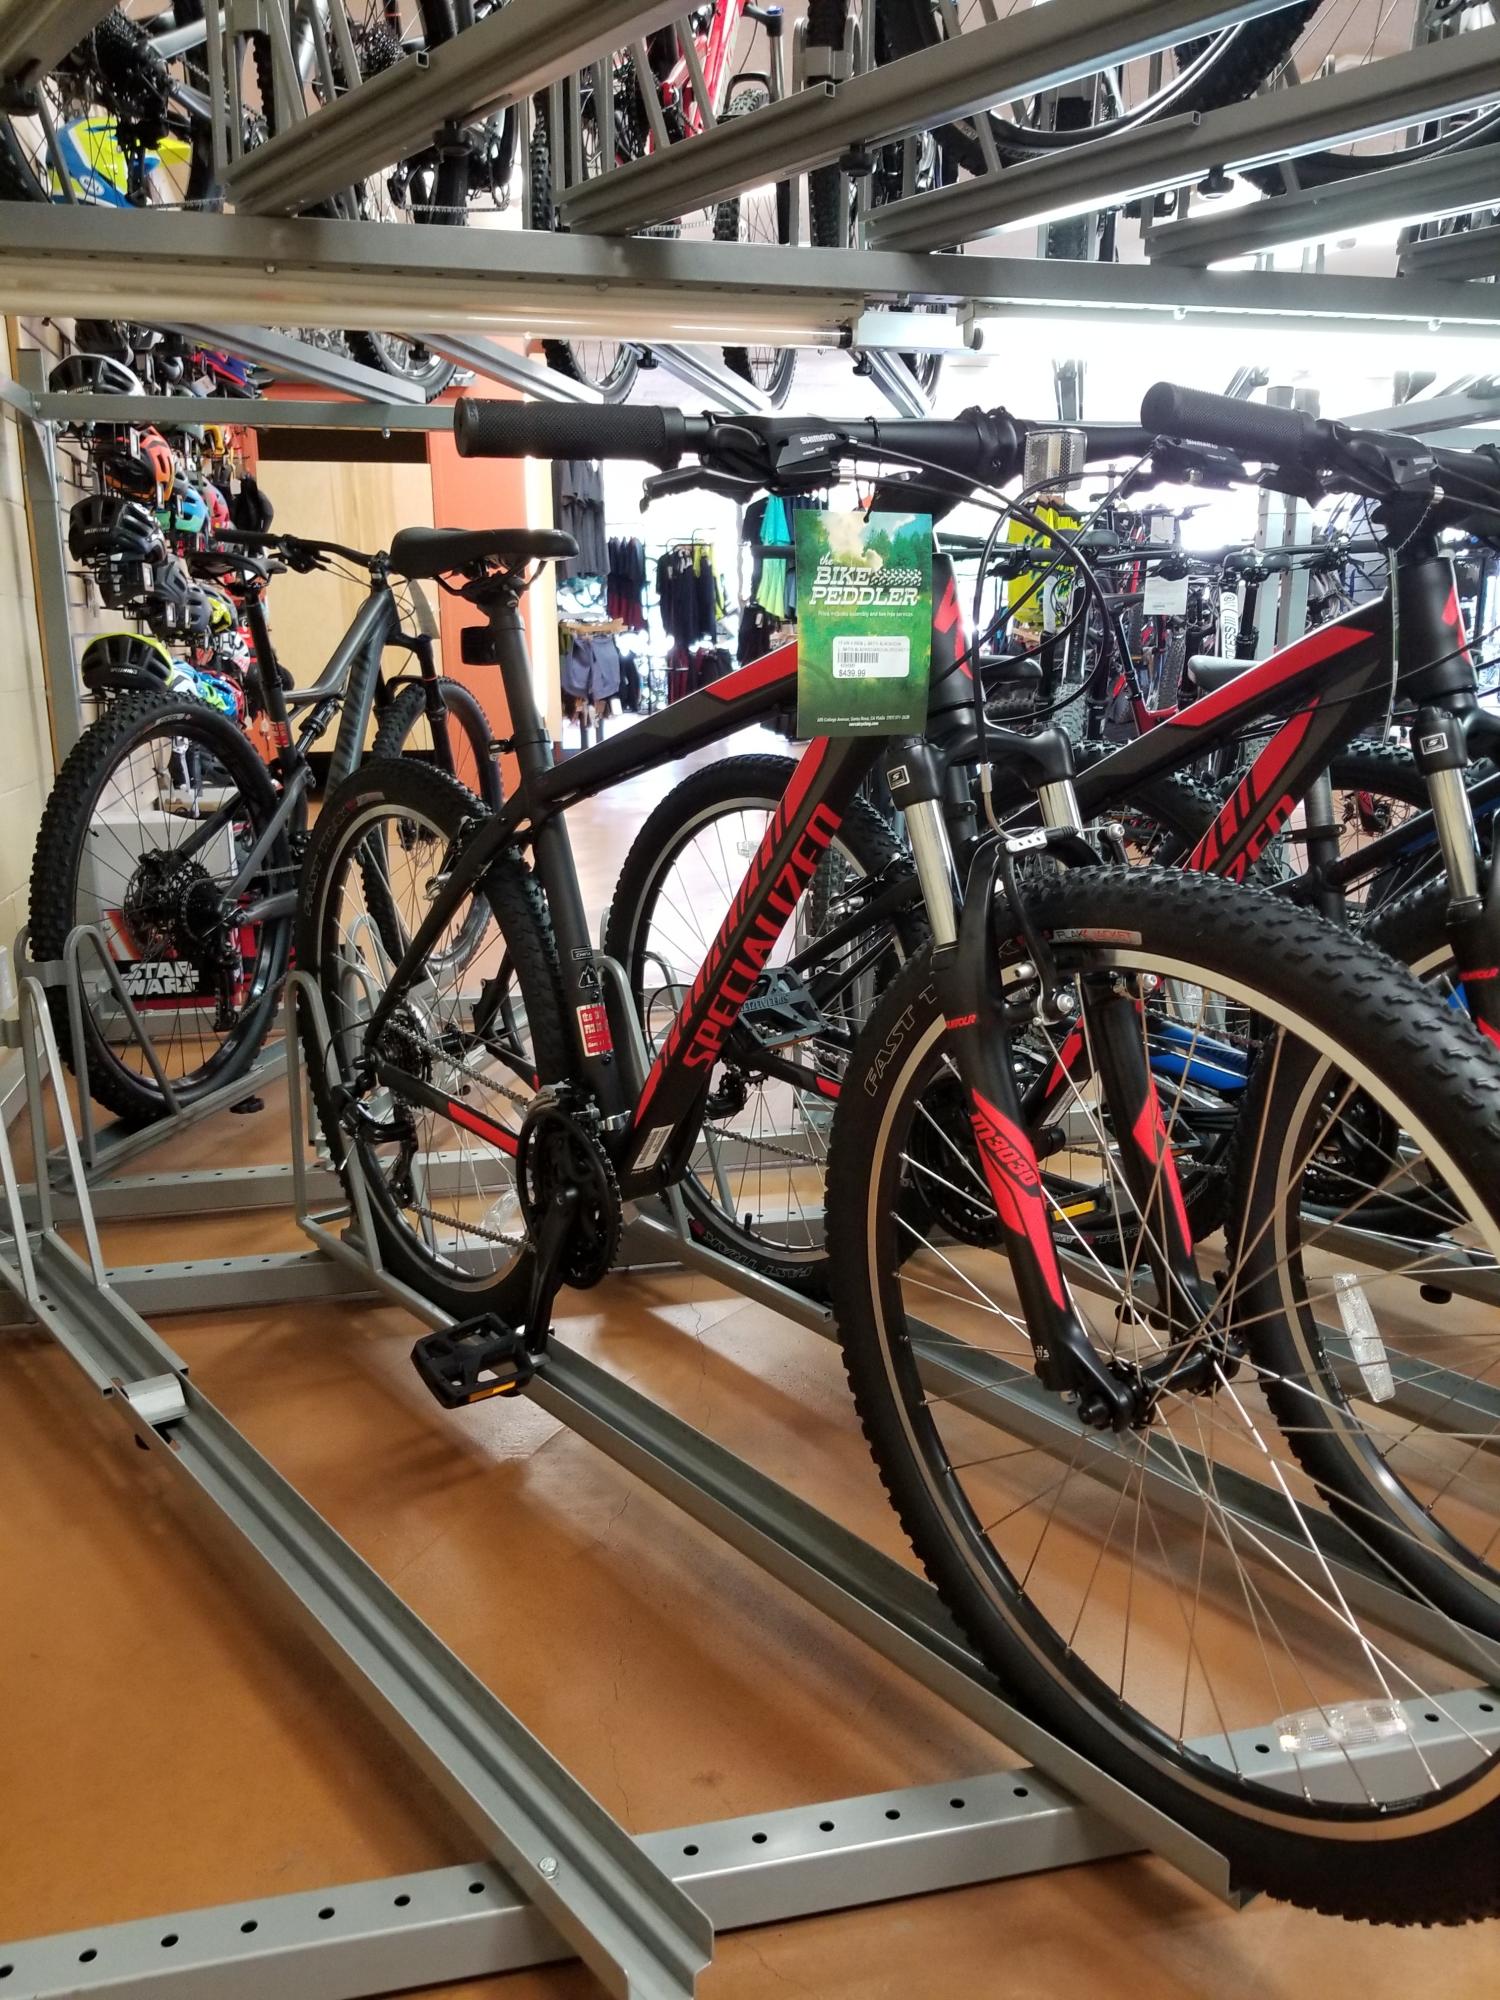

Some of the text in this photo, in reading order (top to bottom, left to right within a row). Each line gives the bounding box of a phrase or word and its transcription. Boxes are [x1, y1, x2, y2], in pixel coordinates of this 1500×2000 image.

[800, 433, 836, 444] SHIMANO
[820, 551, 833, 566] the
[813, 566, 872, 586] BIKE
[808, 586, 919, 606] PEDDLER
[838, 669, 866, 677] $439.99
[682, 802, 842, 1072] SPECIALIZED
[120, 961, 199, 980] STAR
[121, 977, 200, 996] WARS
[863, 1004, 914, 1097] FAST
